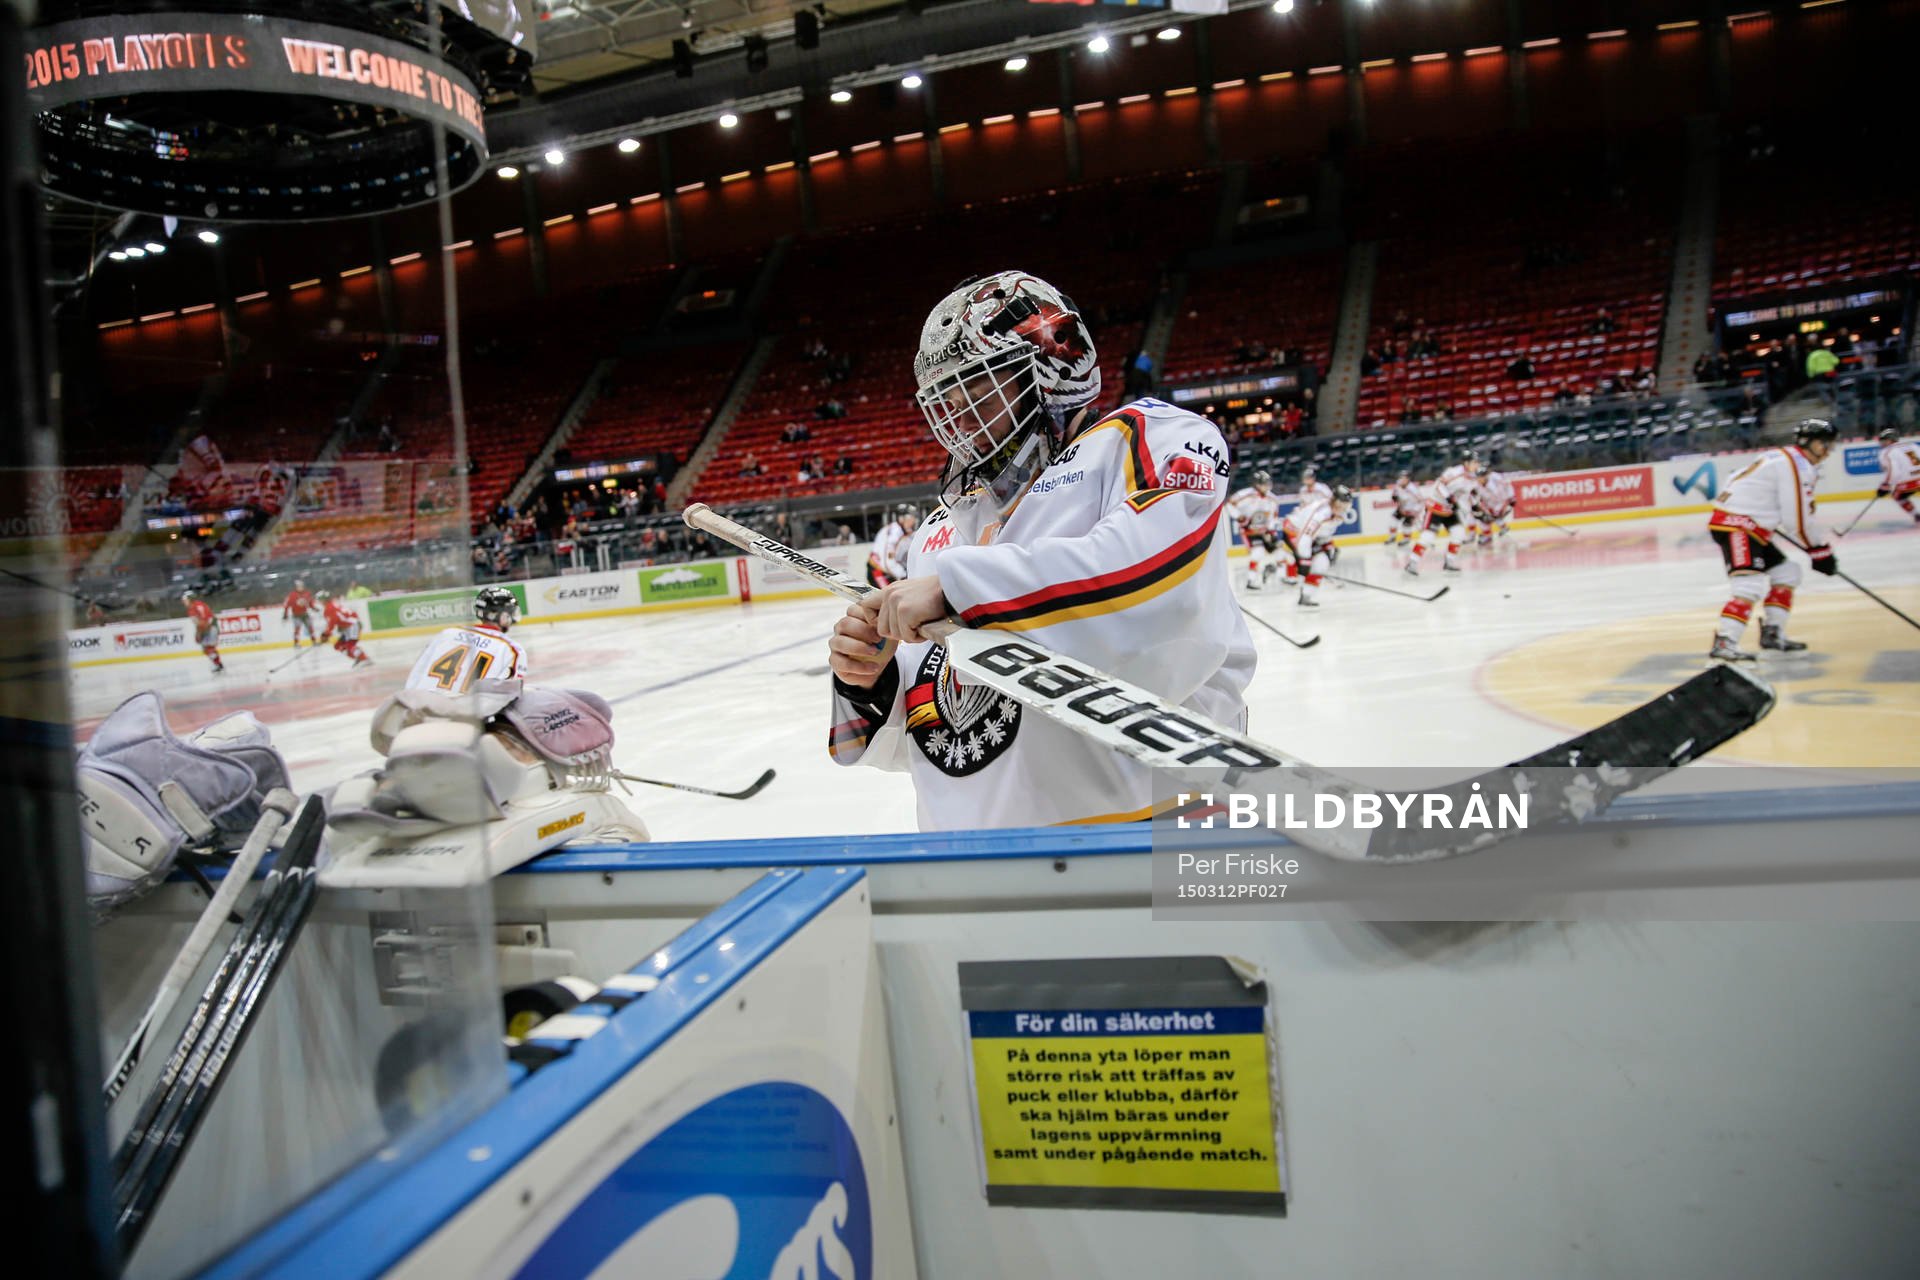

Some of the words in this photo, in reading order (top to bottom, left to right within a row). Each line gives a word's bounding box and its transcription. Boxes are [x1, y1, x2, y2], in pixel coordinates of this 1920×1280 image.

[24, 44, 80, 89] 2015
[281, 37, 427, 99] WELCOME
[427, 71, 454, 110] TO
[1184, 441, 1230, 478] LKAB
[1520, 481, 1596, 500] MORRIS
[1599, 474, 1643, 492] LAW
[558, 583, 621, 600] EASTON
[428, 644, 495, 694] 41
[543, 714, 580, 734] LARSSON
[544, 708, 573, 725] DANIEL
[1016, 1014, 1054, 1032] För
[1061, 1014, 1097, 1031] din
[1106, 1012, 1214, 1031] säkerhet
[1008, 1049, 1029, 1062] På
[1036, 1050, 1091, 1062] denna
[1099, 1050, 1127, 1065] yta
[1134, 1049, 1182, 1064] löper
[1190, 1051, 1230, 1060] man
[1008, 1071, 1062, 1082] större
[1069, 1070, 1102, 1082] risk
[1110, 1070, 1134, 1081] att
[1142, 1069, 1205, 1081] träffas
[1214, 1071, 1234, 1080] av
[1008, 1090, 1050, 1104] puck
[1058, 1090, 1097, 1101] eller
[1105, 1089, 1174, 1103] klubba,
[1181, 1088, 1238, 1101] därför
[1020, 1109, 1051, 1121] ska
[1058, 1109, 1108, 1124] hjälm
[1115, 1110, 1168, 1121] bäras
[1175, 1109, 1228, 1121] under
[1031, 1128, 1091, 1143] lagens
[1098, 1129, 1221, 1144] uppvärmning
[994, 1148, 1037, 1158] samt
[1044, 1148, 1095, 1160] under
[1102, 1147, 1193, 1163] pågående
[1201, 1149, 1266, 1160] match.
